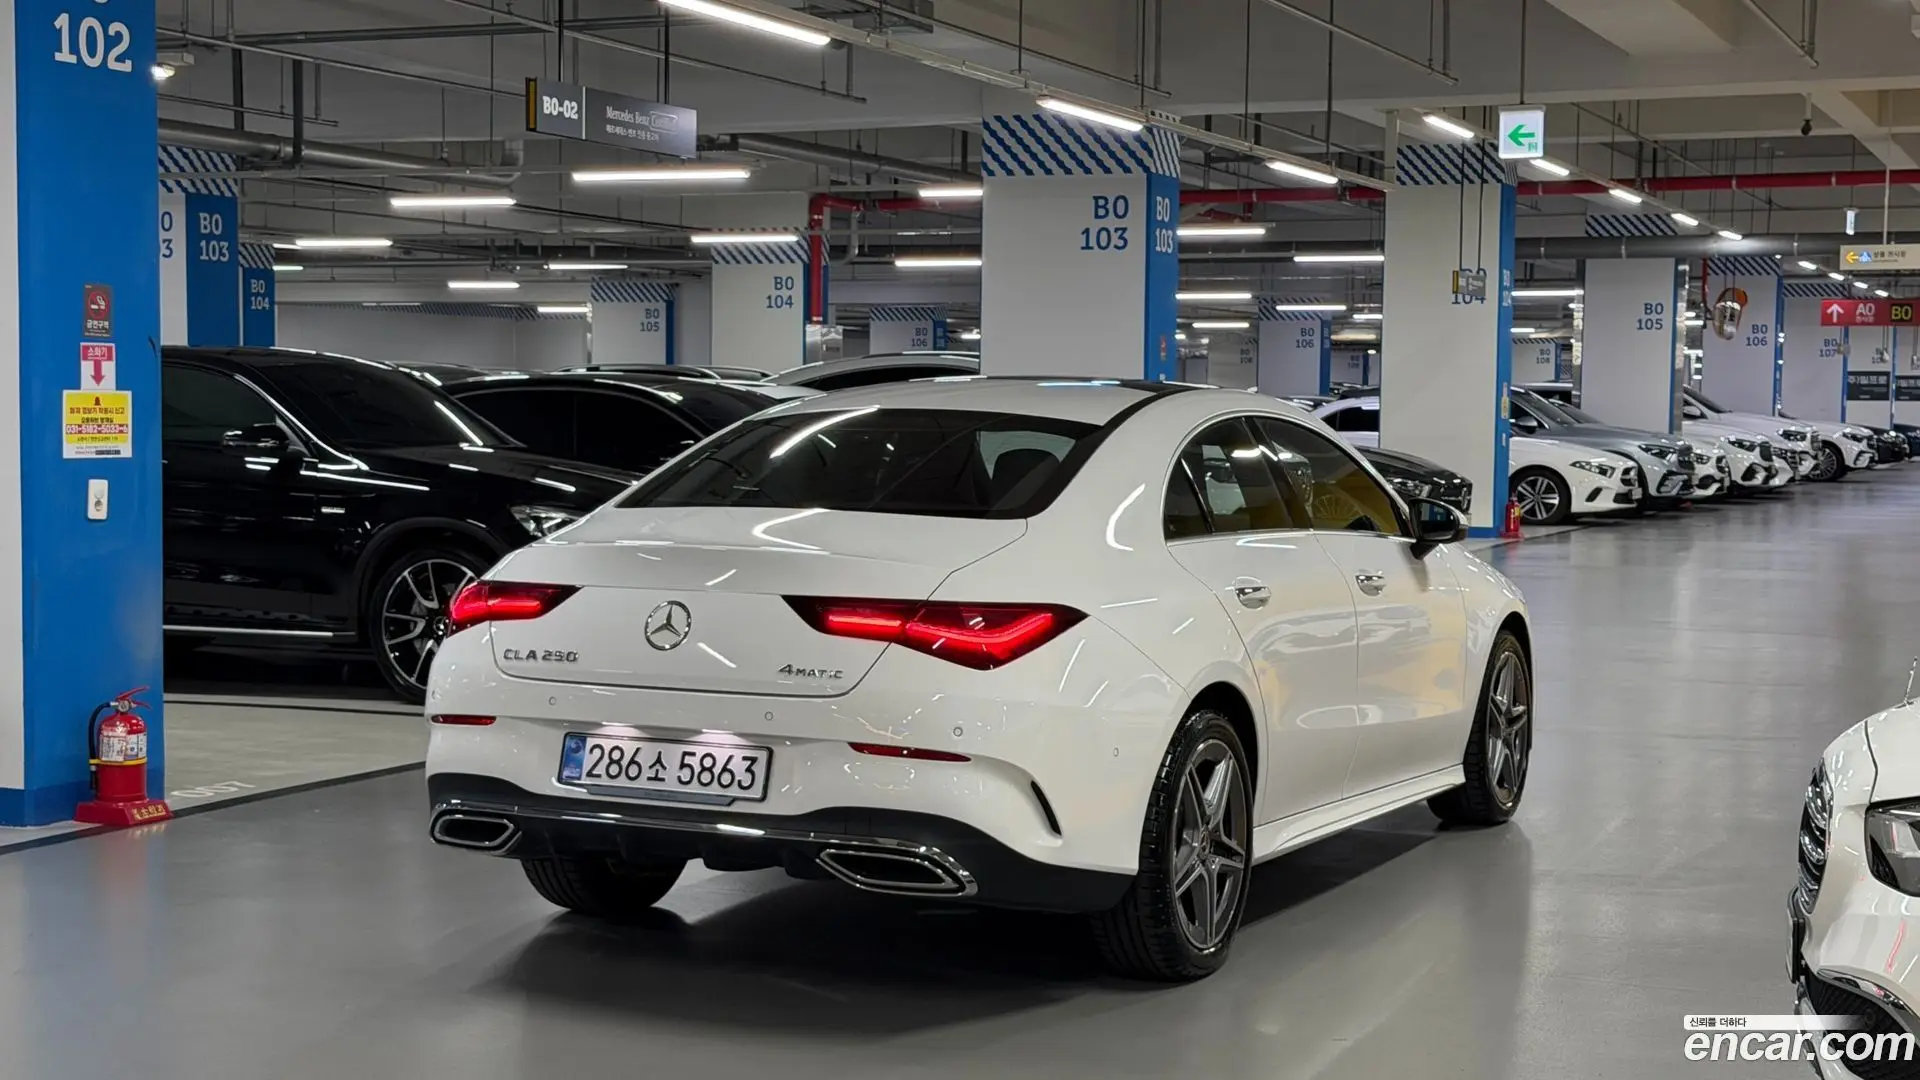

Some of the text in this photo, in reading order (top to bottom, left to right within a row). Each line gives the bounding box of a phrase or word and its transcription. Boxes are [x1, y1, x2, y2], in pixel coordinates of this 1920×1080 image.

[53, 12, 133, 73] 102
[542, 95, 579, 120] B0-02
[606, 105, 635, 123] Mercedes
[1092, 194, 1129, 220] B0
[1156, 195, 1170, 222] B0
[199, 212, 223, 235] B0
[1080, 226, 1129, 251] 103
[1155, 227, 1173, 254] 103
[199, 239, 230, 262] 103
[250, 278, 266, 293] B0
[773, 276, 795, 291] B0
[250, 296, 270, 310] 104
[765, 295, 795, 309] 104
[1643, 302, 1665, 316] B0
[644, 308, 660, 320] B0
[1855, 303, 1912, 321] A0 B0
[639, 321, 660, 333] 105
[1300, 327, 1315, 337] B0
[1636, 318, 1664, 331] 105
[1751, 324, 1768, 335] B0
[1295, 339, 1315, 349] 106
[1745, 336, 1768, 347] 106
[503, 648, 579, 662] CLA 250
[778, 663, 844, 680] 4MATIC
[585, 743, 760, 791] 286소 5863
